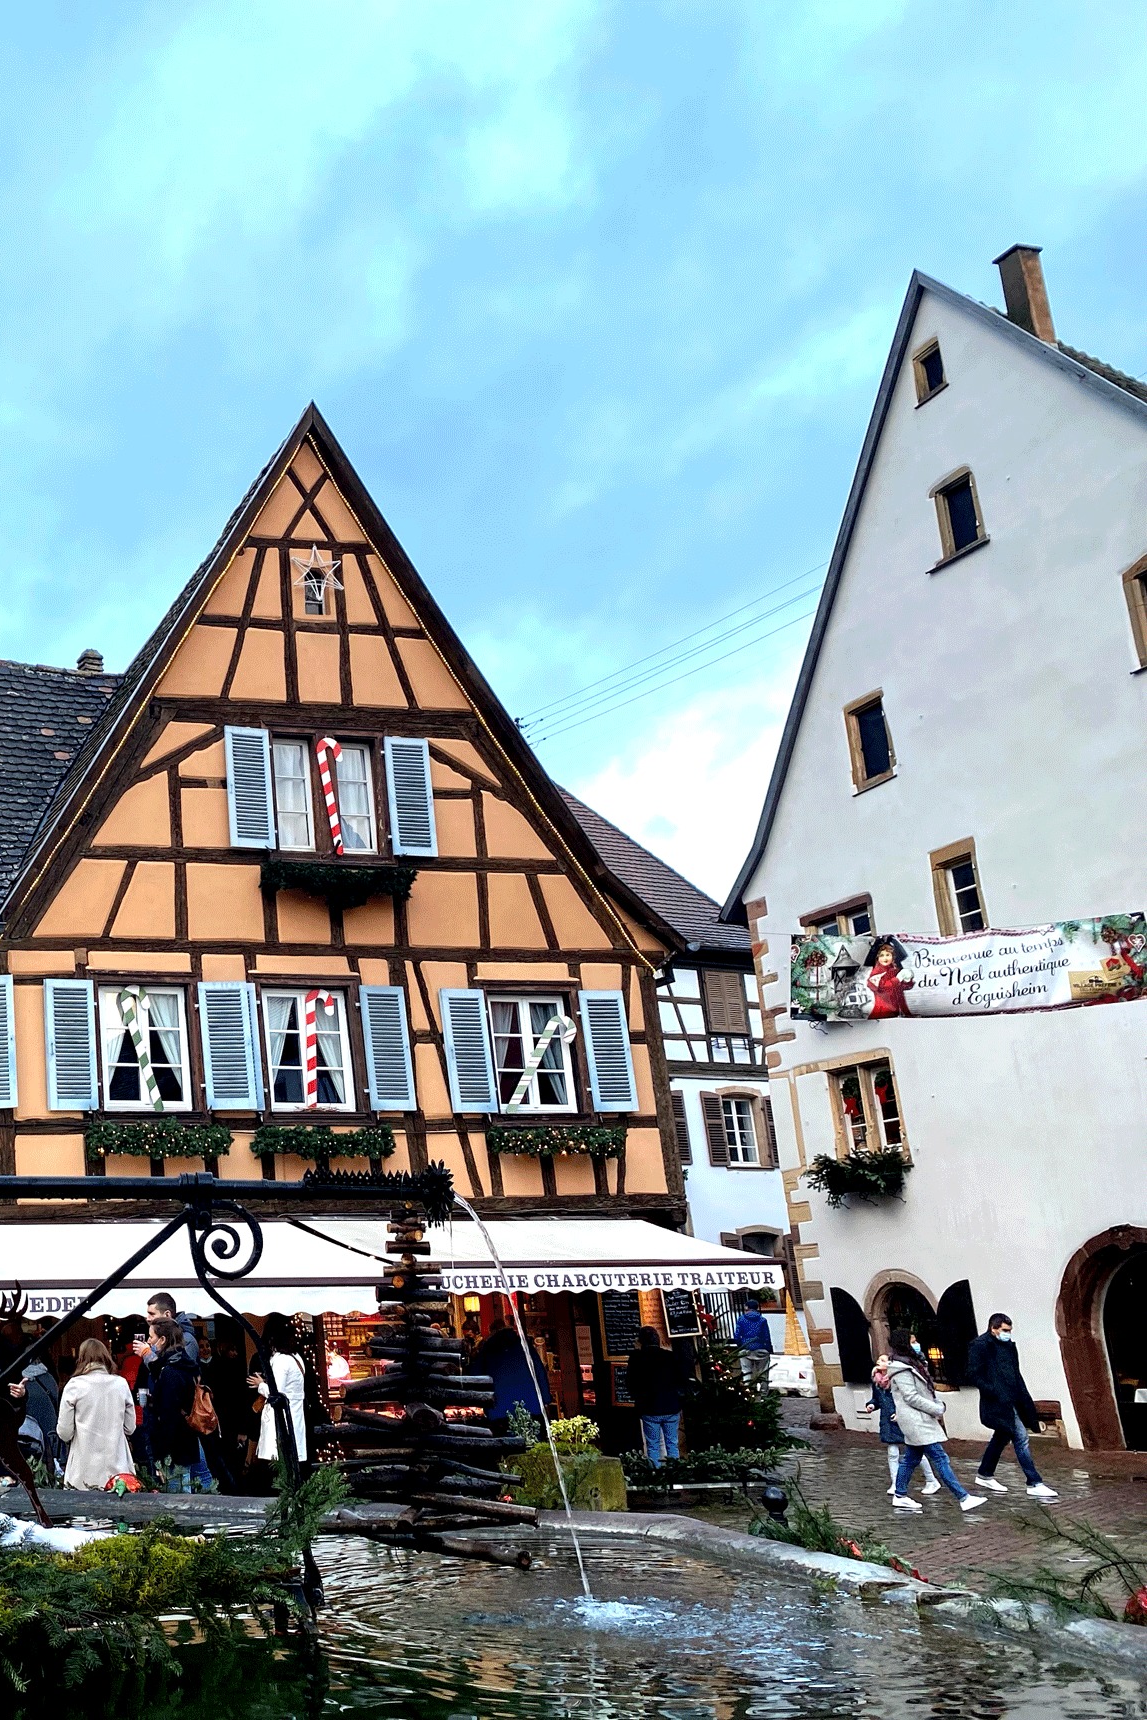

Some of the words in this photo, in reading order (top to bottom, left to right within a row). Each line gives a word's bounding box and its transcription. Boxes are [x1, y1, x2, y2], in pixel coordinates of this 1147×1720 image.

[913, 948, 993, 968] Bienvenue
[999, 945, 1018, 956] au
[1022, 937, 1064, 953] temps
[918, 974, 939, 989] du
[940, 965, 984, 987] Noël
[988, 958, 1071, 980] authentique
[952, 983, 1049, 1009] d'Eguisheim
[441, 1274, 529, 1290] UCHERIE
[533, 1273, 674, 1289] CHARCUTERIE
[677, 1271, 776, 1286] TRAITEUR
